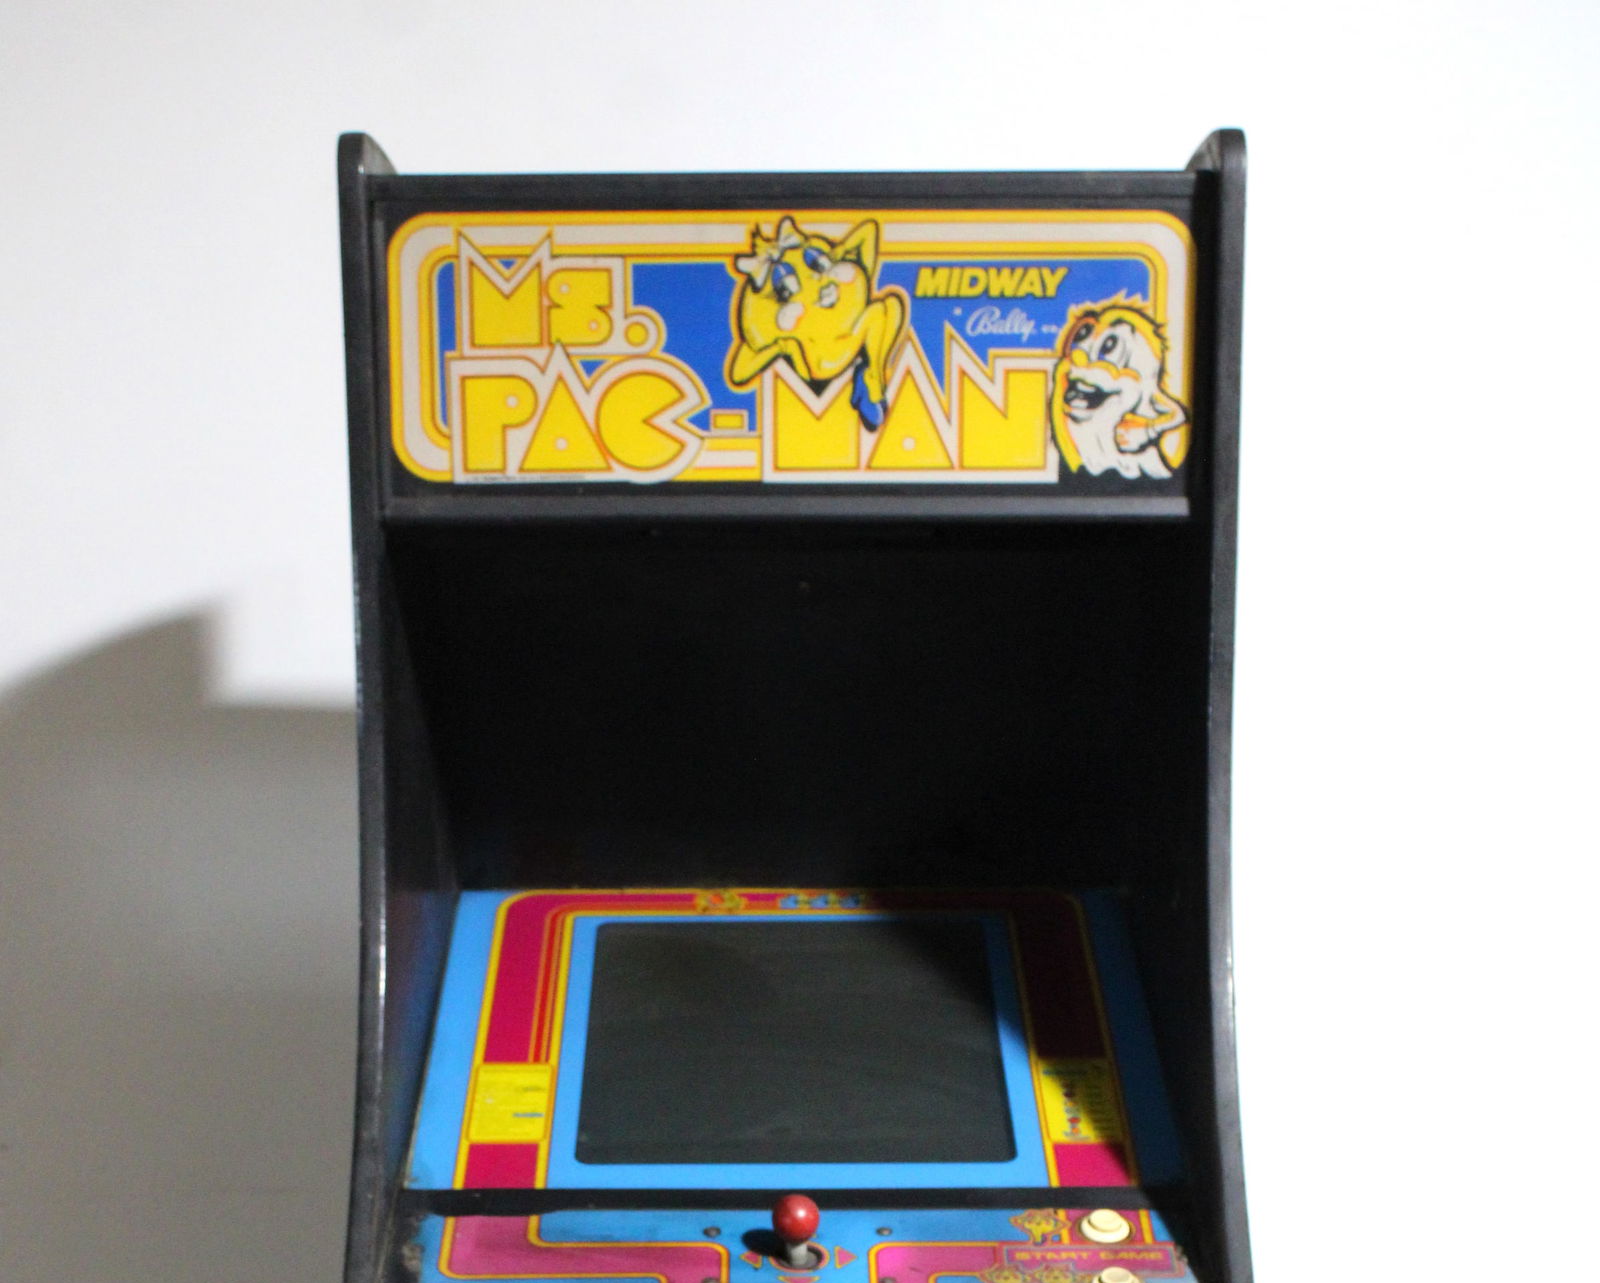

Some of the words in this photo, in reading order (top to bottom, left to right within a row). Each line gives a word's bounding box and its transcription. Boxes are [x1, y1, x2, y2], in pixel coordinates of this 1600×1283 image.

[913, 266, 1069, 299] MIDWAY
[455, 348, 1058, 480] PAC-MAN
[1015, 1251, 1090, 1261] START
[1100, 1251, 1164, 1261] GAME
